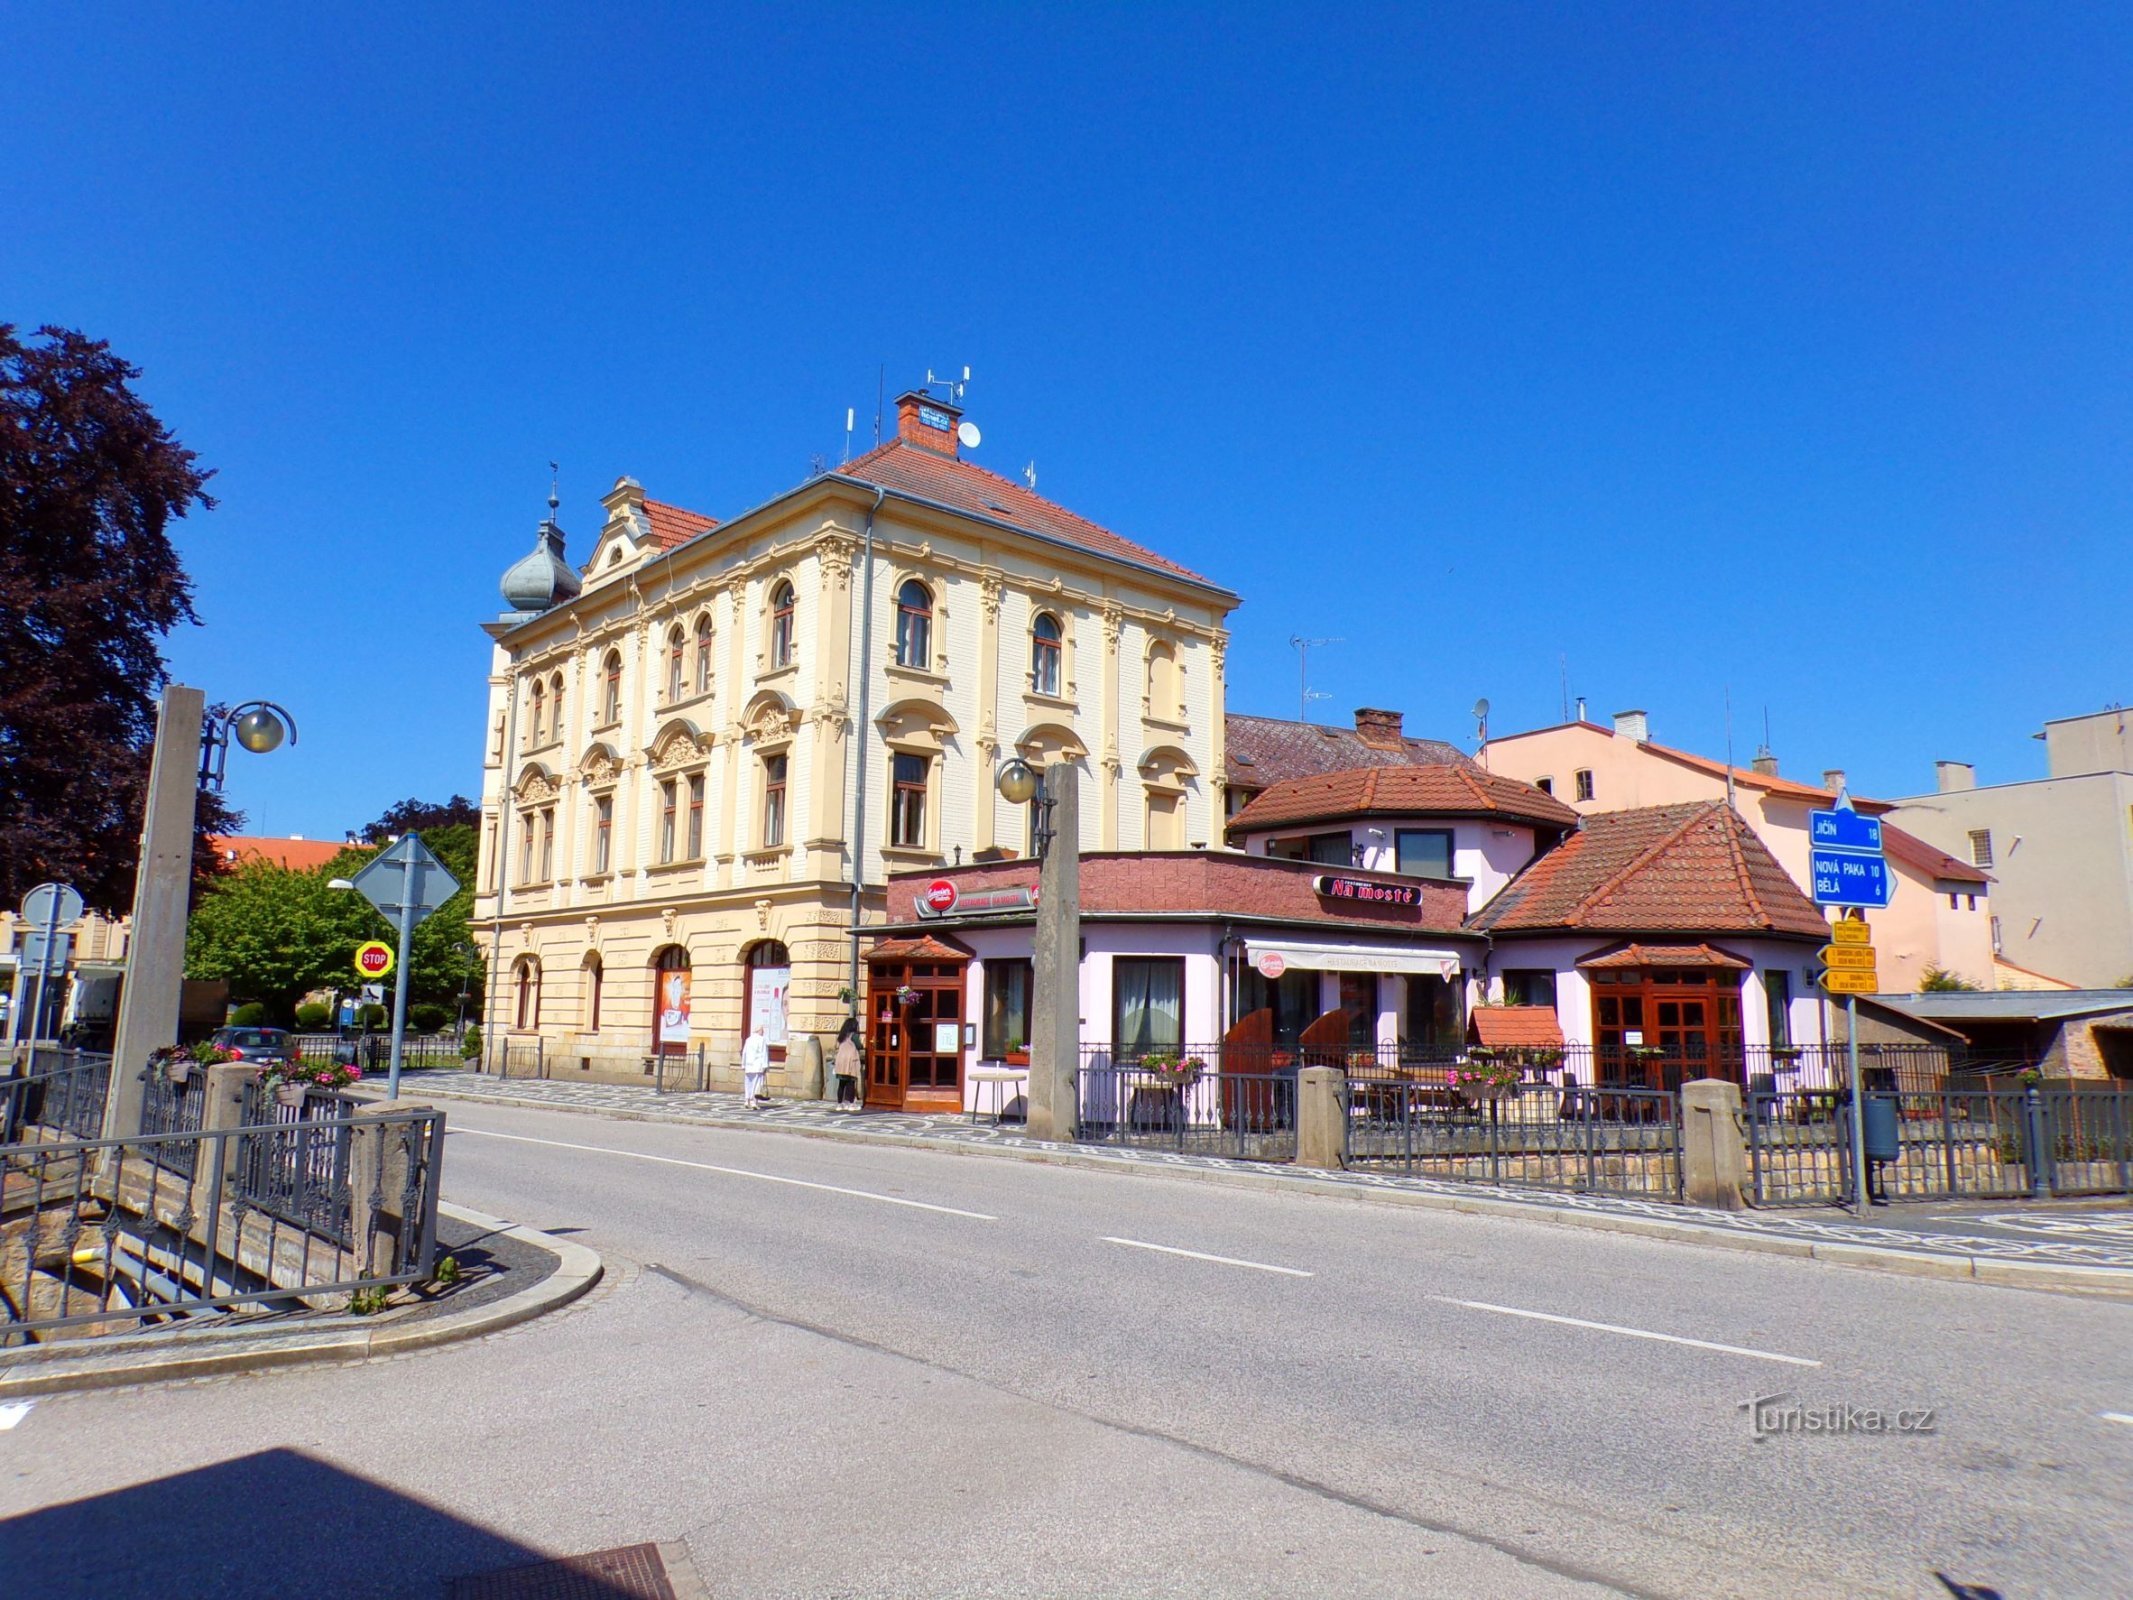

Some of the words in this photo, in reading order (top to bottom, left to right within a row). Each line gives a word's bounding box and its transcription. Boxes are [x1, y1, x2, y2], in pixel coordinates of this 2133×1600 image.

[1815, 820, 1837, 836] JIČÍN
[1868, 828, 1878, 840] 18
[1815, 859, 1840, 874] NOVÁ
[1843, 862, 1866, 877] PAKA
[1870, 865, 1880, 878] 10
[1331, 879, 1354, 897] Na
[1358, 886, 1413, 903] mostě
[1817, 877, 1840, 893] BĚLÁ
[1875, 884, 1881, 896] 6
[363, 953, 387, 965] STOP
